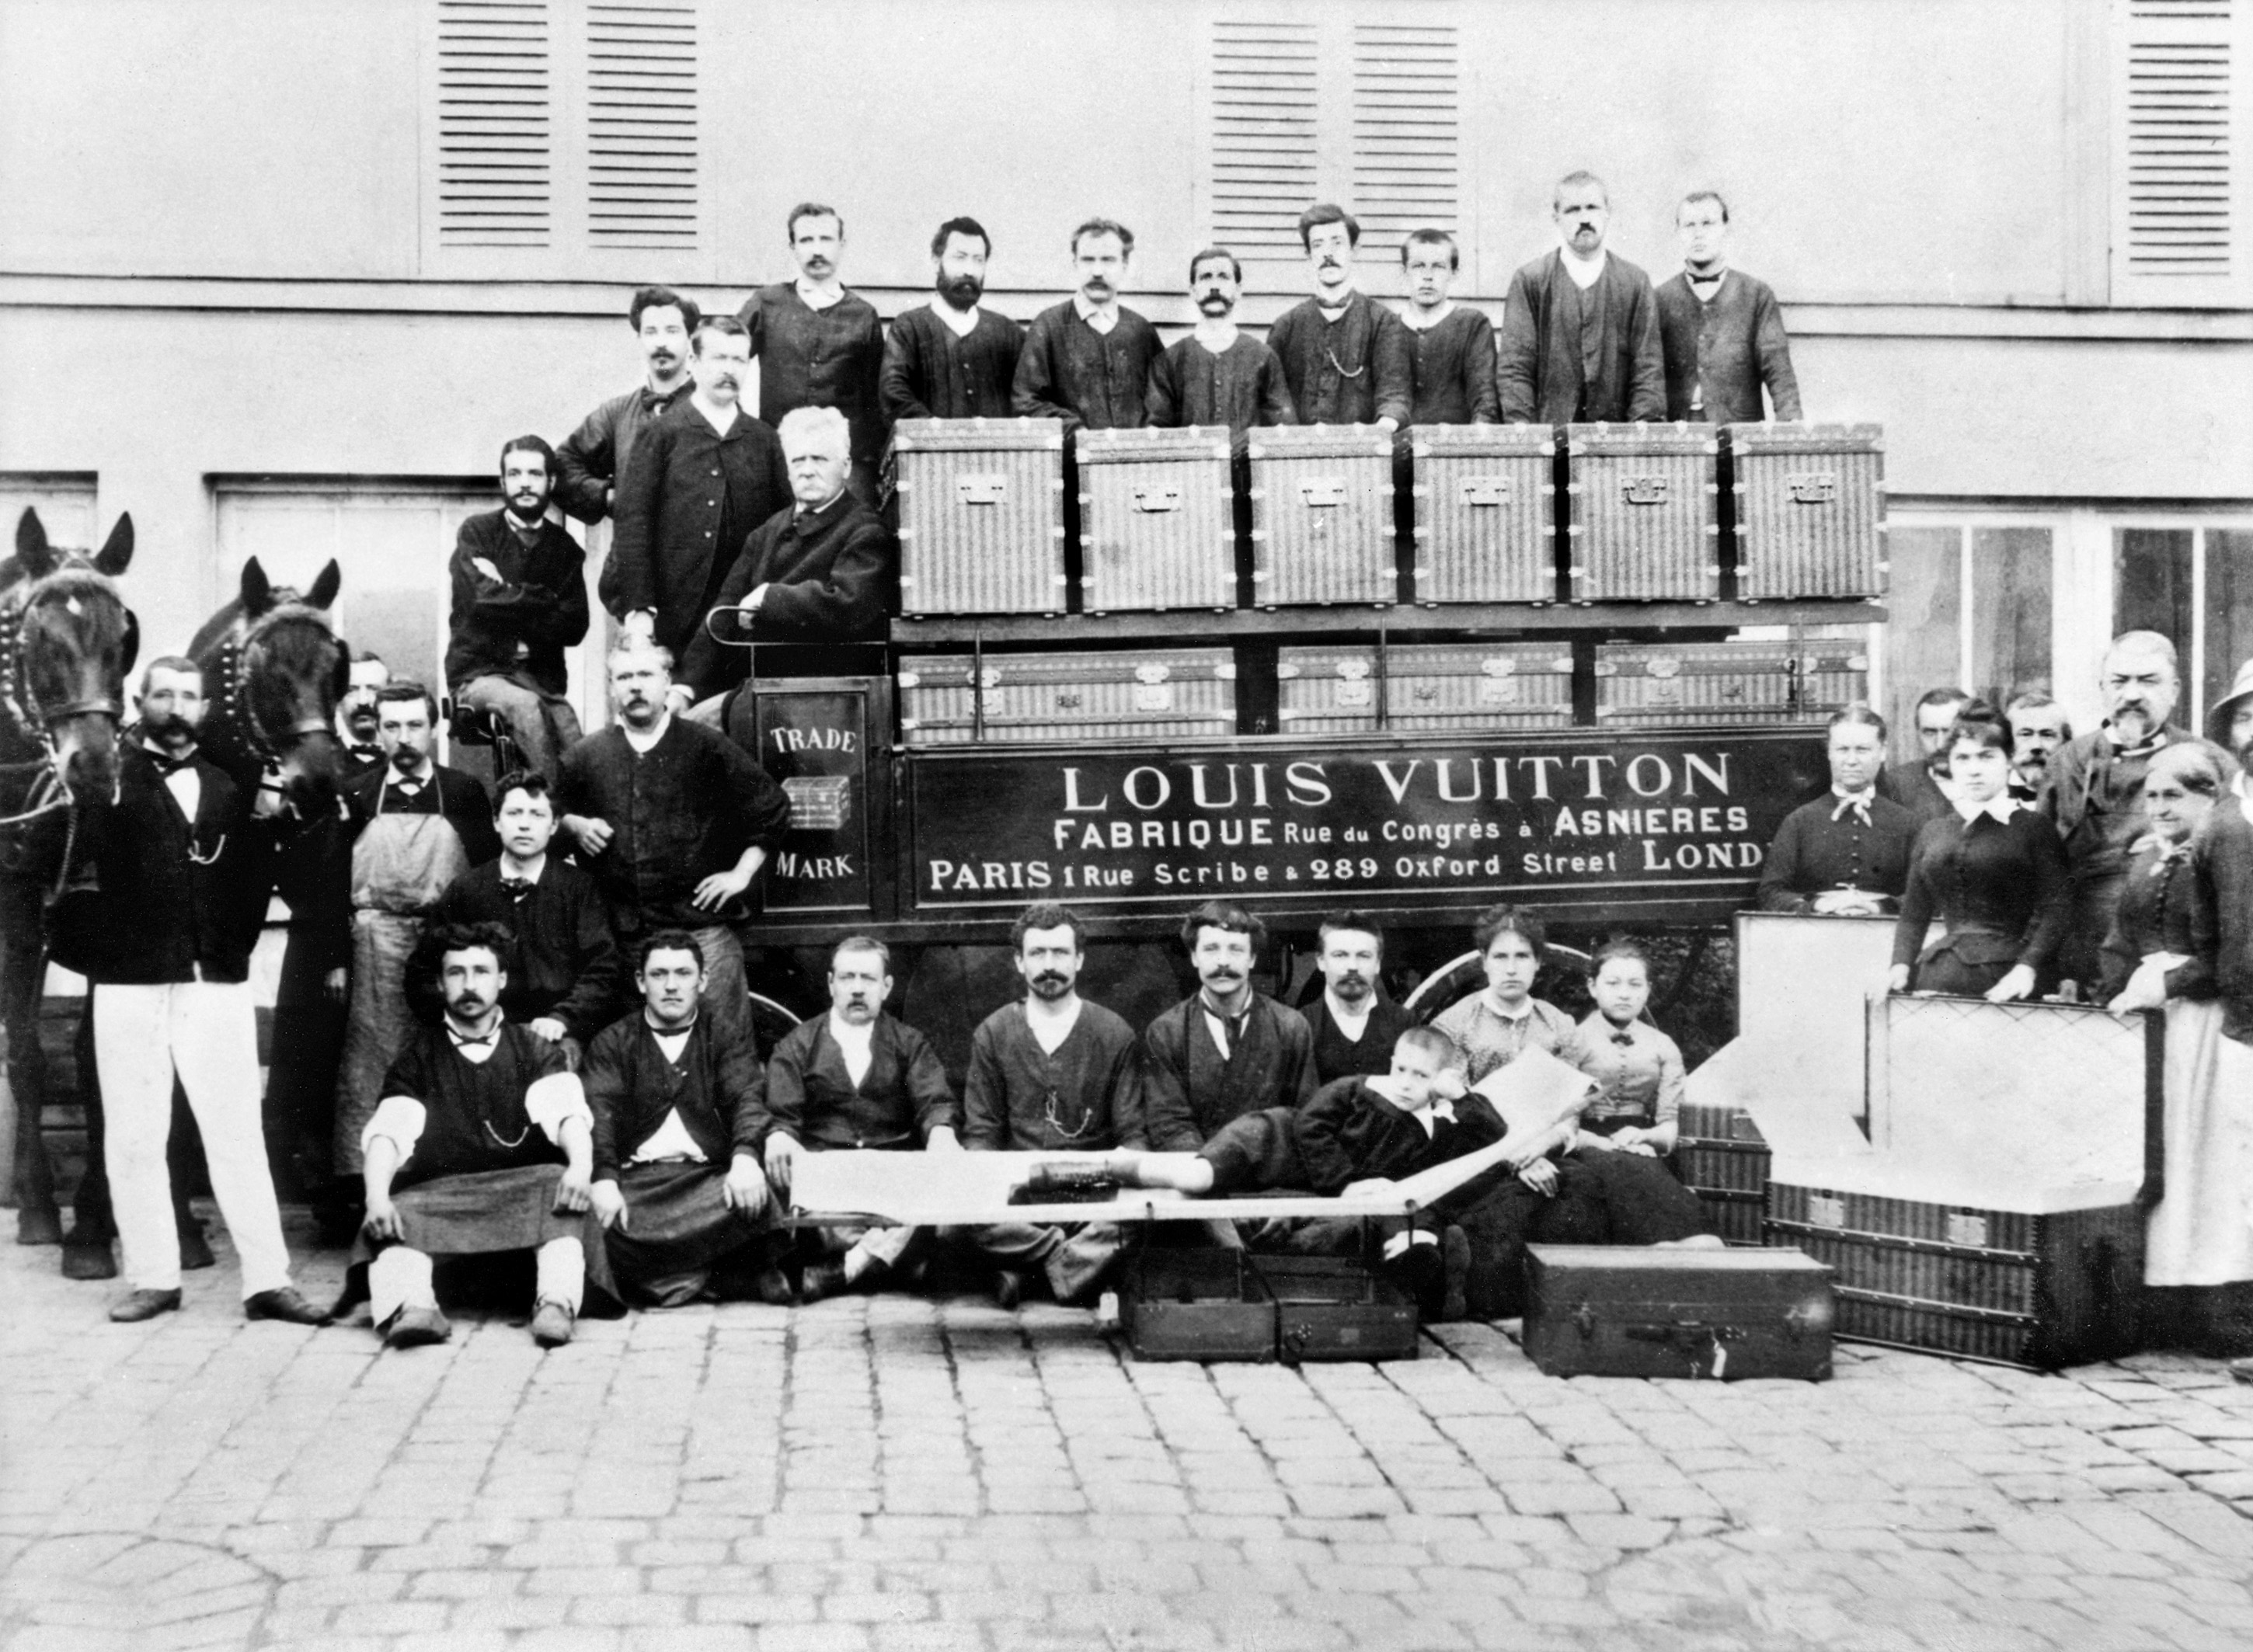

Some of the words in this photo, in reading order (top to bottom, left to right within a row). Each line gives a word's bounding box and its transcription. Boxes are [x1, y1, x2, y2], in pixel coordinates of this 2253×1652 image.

[770, 726, 857, 753] TRADE
[1063, 760, 1332, 812] LOUIS
[1370, 752, 1731, 805] VUITTON
[1053, 817, 1273, 850] FABRIQUE
[1284, 822, 1332, 843] Rue
[1343, 826, 1369, 842] du
[1382, 819, 1500, 850] Congrès
[1553, 805, 1749, 836] ASNIERES
[775, 850, 858, 879] MARK
[929, 861, 1052, 891] PARIS
[1063, 865, 1075, 888] 1
[1083, 864, 1134, 887] Rue
[1154, 861, 1269, 885] Scribe
[1285, 865, 1299, 881] &
[1310, 857, 1379, 880] 289
[1395, 854, 1501, 878] Oxford
[1522, 850, 1617, 875] Street
[1642, 839, 1772, 871] LOND
